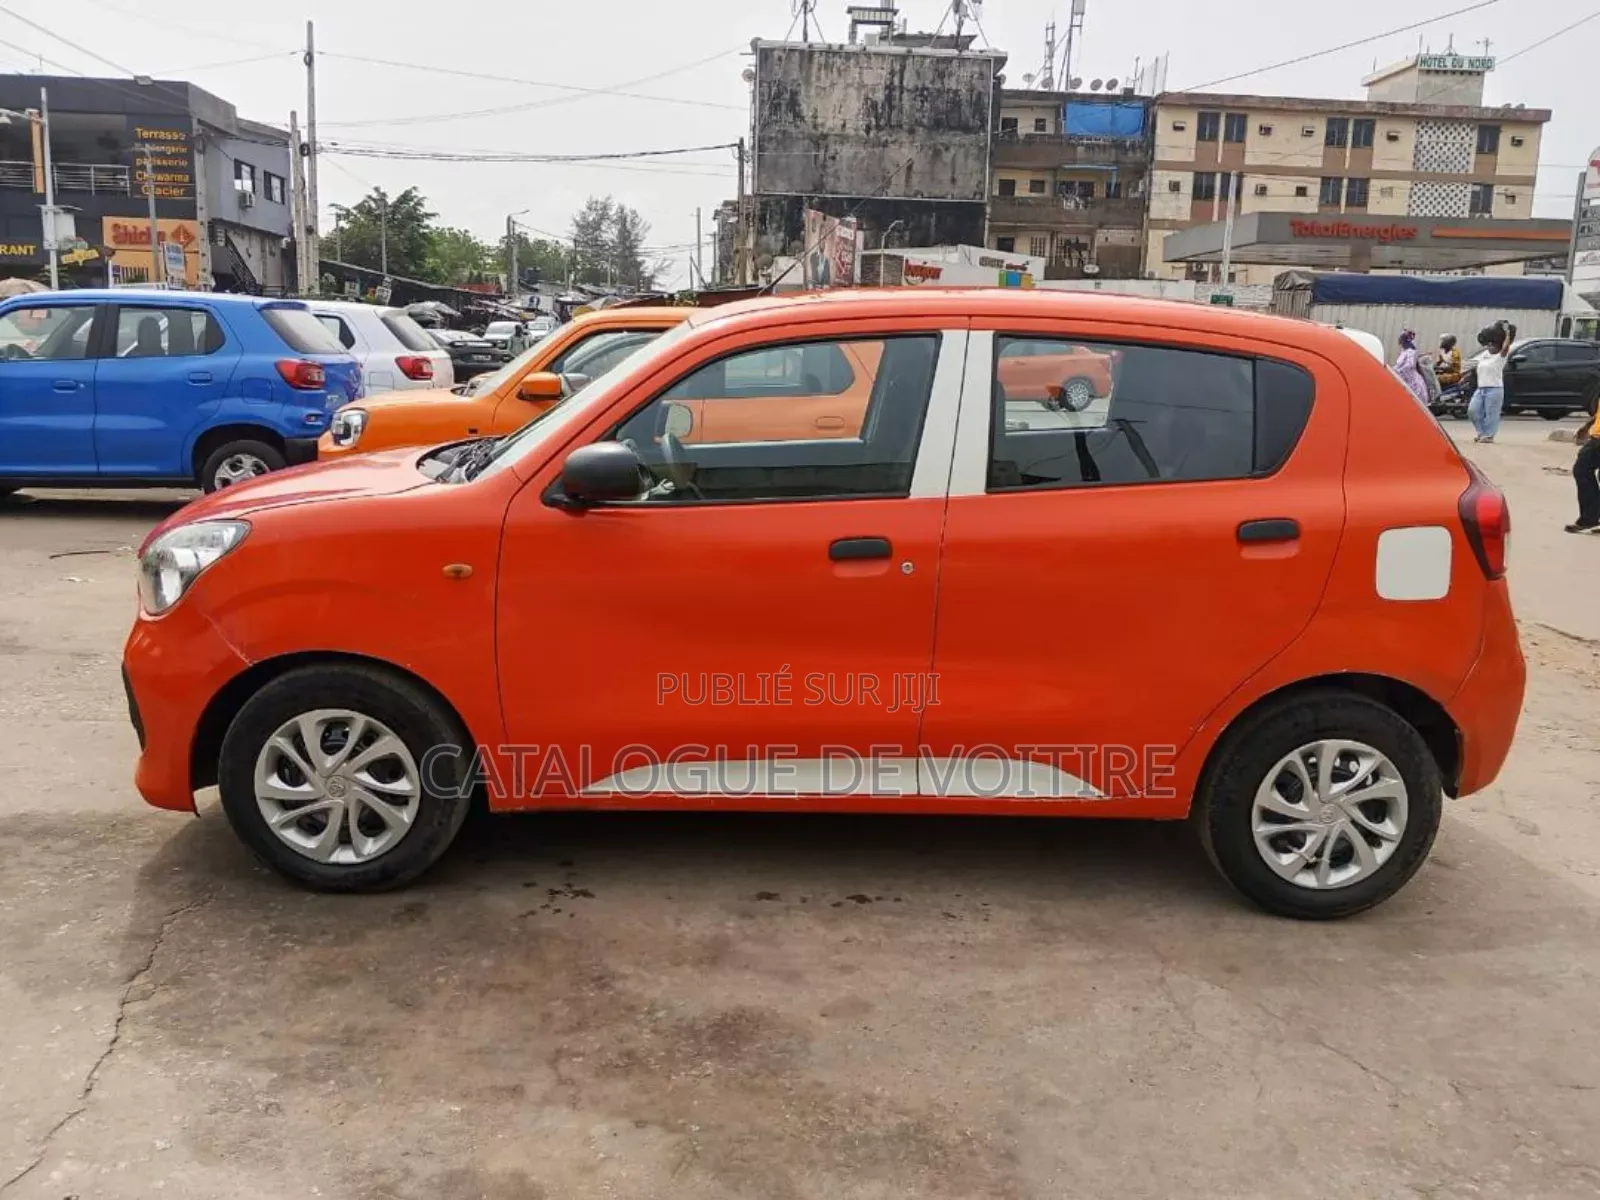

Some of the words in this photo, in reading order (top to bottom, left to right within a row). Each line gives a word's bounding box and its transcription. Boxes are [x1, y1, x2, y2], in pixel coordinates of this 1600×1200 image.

[1452, 58, 1464, 69] DU
[1468, 58, 1493, 69] NORD
[135, 171, 189, 183] Chwarma
[141, 184, 186, 195] Gacier
[1289, 218, 1418, 244] TotalEnergies
